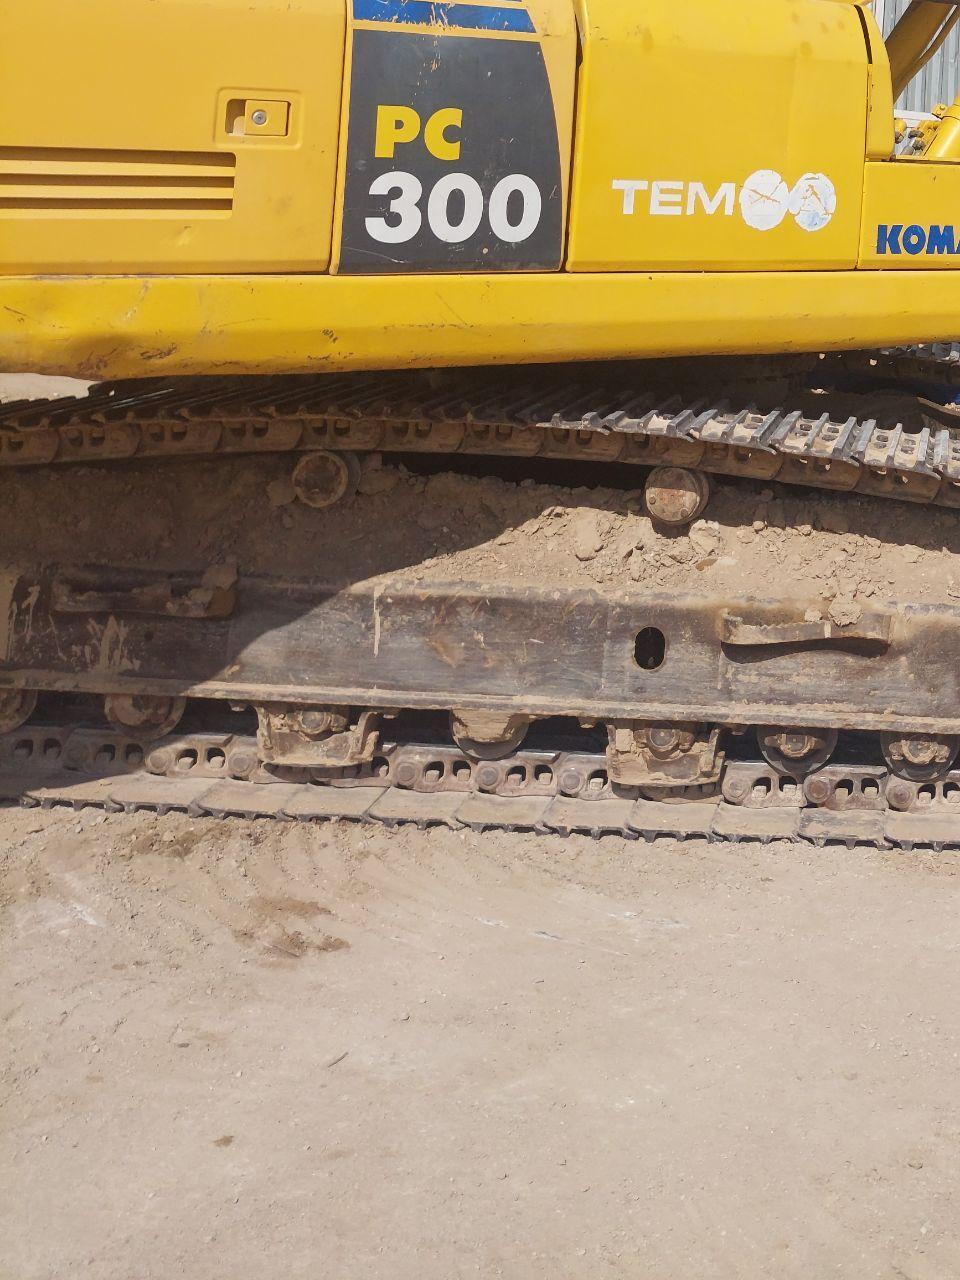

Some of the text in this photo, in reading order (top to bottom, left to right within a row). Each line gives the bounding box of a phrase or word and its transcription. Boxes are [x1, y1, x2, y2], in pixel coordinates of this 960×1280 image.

[374, 104, 463, 161] PC
[364, 170, 542, 244] 300
[611, 169, 837, 232] TEM
